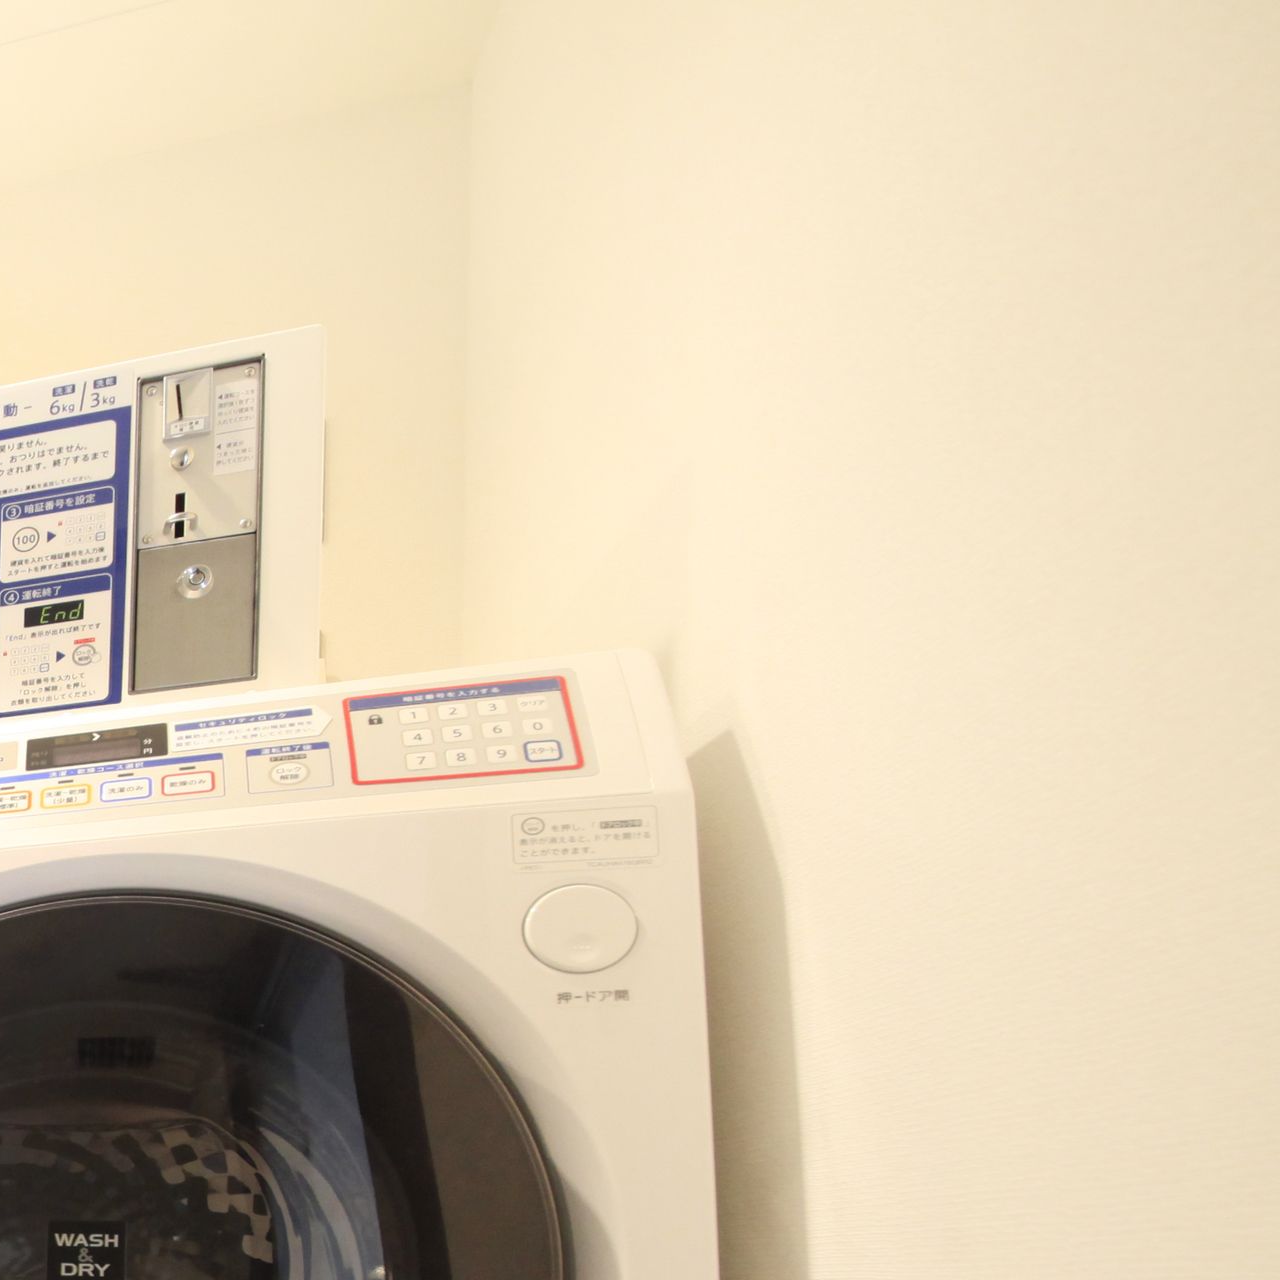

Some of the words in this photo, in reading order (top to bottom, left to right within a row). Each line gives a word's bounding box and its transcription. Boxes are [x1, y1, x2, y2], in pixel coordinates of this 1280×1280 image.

[49, 400, 75, 415] 6kg
[89, 392, 116, 408] 3kg
[24, 494, 96, 513] 暗証番号を設定
[16, 534, 36, 545] 100
[21, 586, 62, 600] 運転終了
[40, 603, 82, 624] End
[448, 707, 458, 716] 2
[488, 703, 498, 711] 3
[410, 711, 417, 720] 1
[493, 725, 503, 734] 6
[533, 722, 544, 731] 0
[413, 733, 423, 742] 4
[453, 729, 462, 738] 5
[456, 752, 466, 762] 8
[496, 749, 507, 758] 9
[416, 756, 426, 765] 7
[54, 1233, 120, 1248] WASH
[78, 1247, 94, 1263] &
[60, 1262, 111, 1278] DRY
